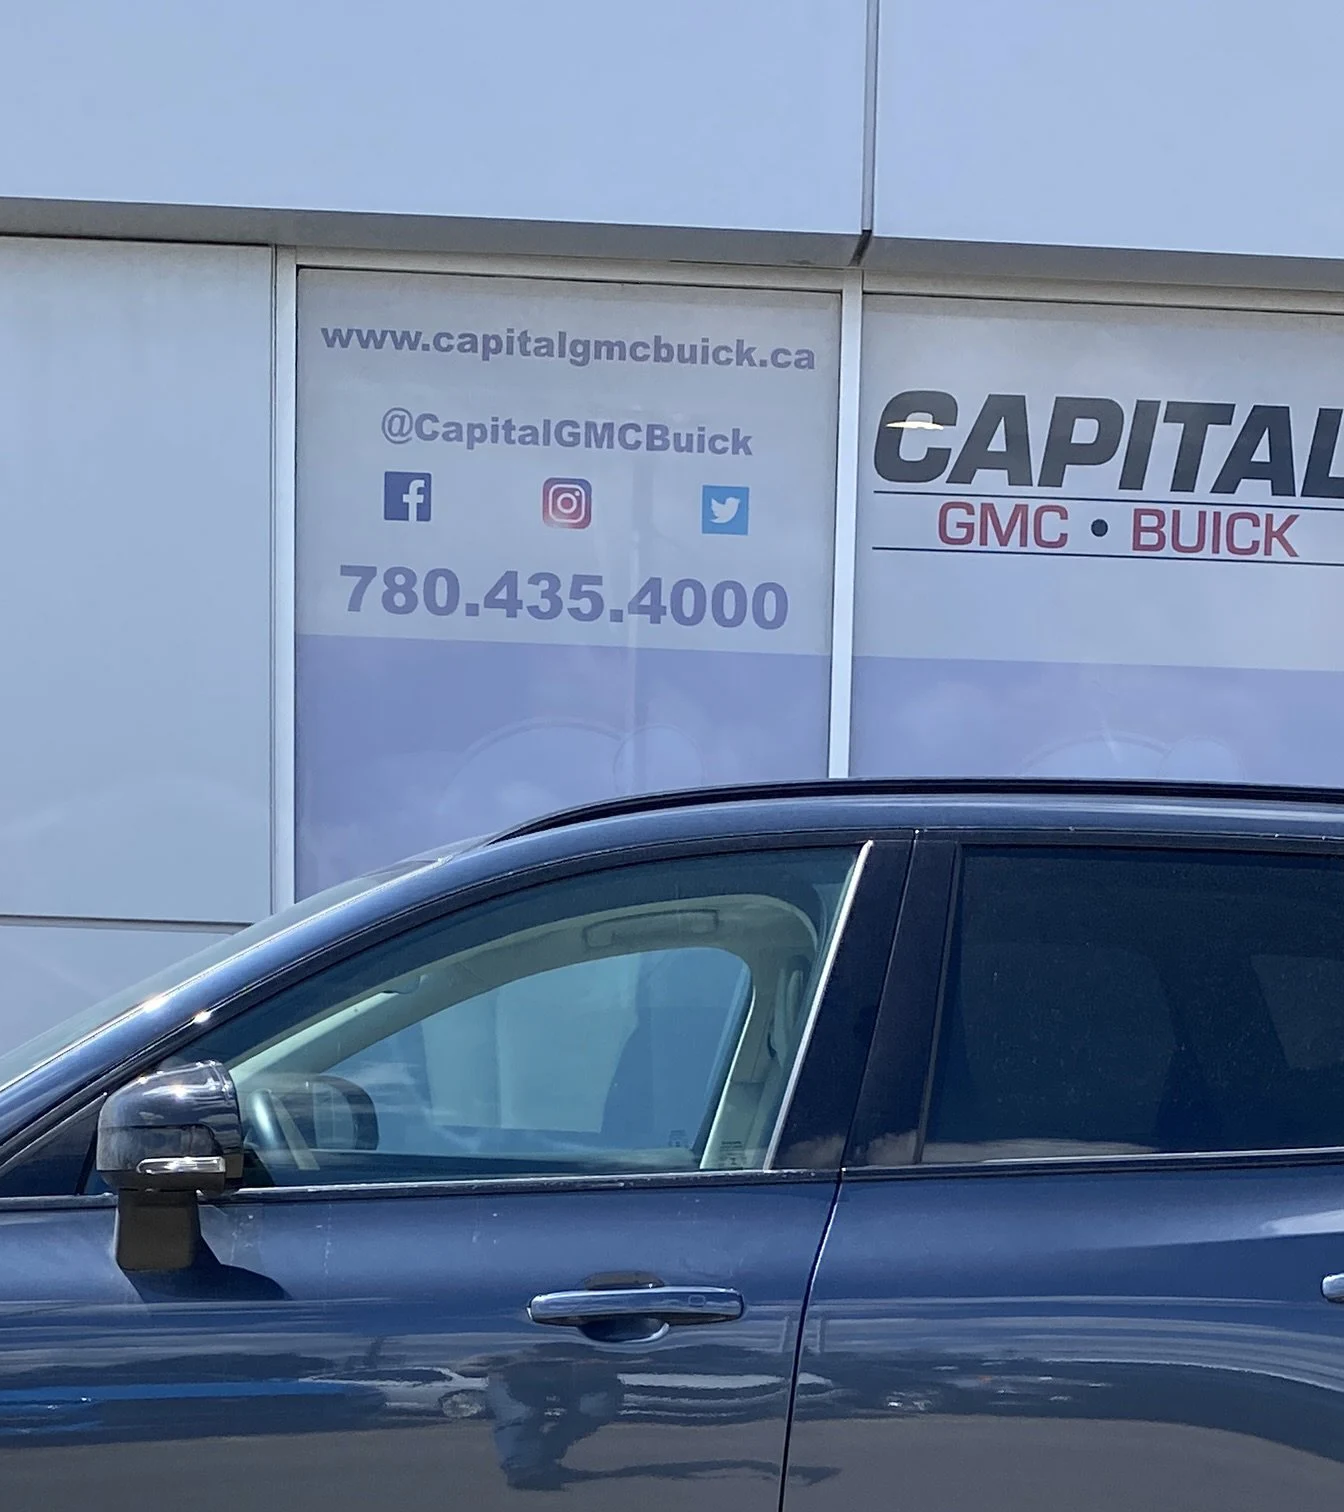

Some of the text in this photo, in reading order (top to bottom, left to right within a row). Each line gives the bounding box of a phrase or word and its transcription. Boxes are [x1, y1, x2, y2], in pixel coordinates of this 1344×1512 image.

[320, 325, 816, 371] www.capitalgmcbuick.ca
[381, 406, 753, 456] @CapitalGMCBuick
[937, 500, 1301, 558] GMC BUICK
[339, 564, 789, 631] 780.435.4000
